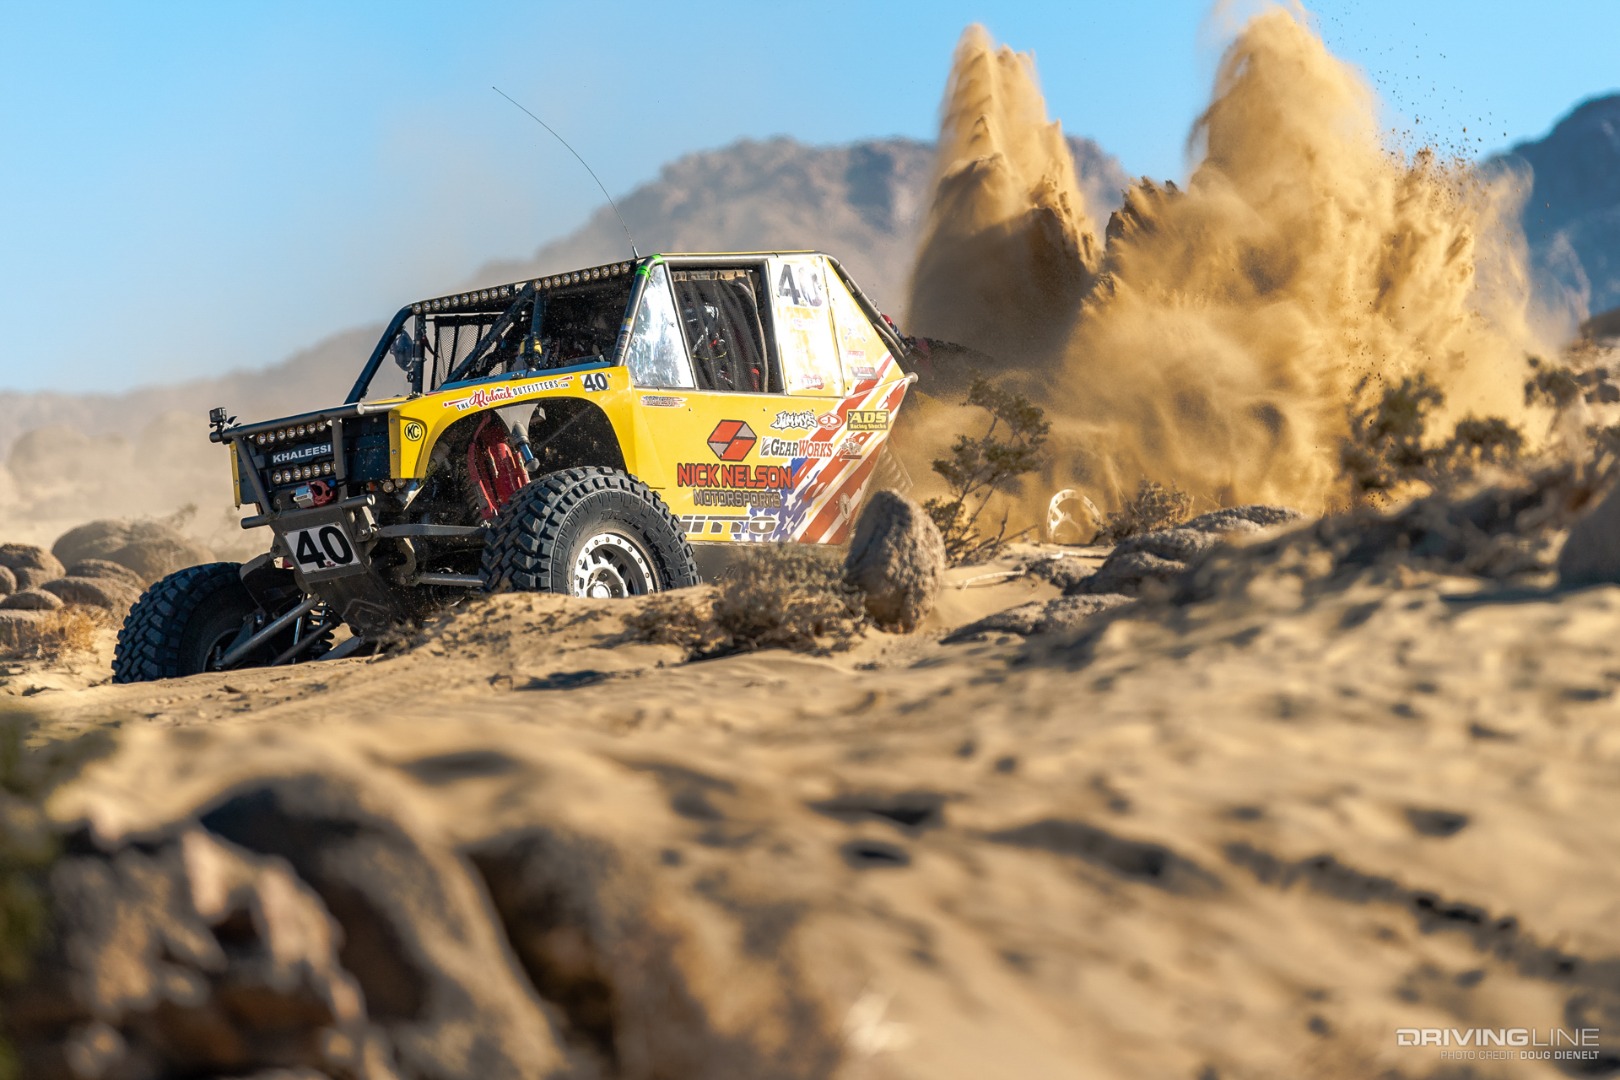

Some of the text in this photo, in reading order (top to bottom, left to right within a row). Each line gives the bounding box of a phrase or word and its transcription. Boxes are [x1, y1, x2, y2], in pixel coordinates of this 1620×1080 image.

[583, 373, 608, 391] 40
[457, 401, 470, 410] THE
[513, 380, 559, 395] OUTFITTERS
[849, 412, 887, 423] ADS
[407, 424, 420, 438] KC
[272, 444, 331, 464] KHALEESI
[677, 463, 793, 488] NICK NELSON
[693, 489, 781, 508] MOTORSPORTS
[296, 526, 354, 569] 40
